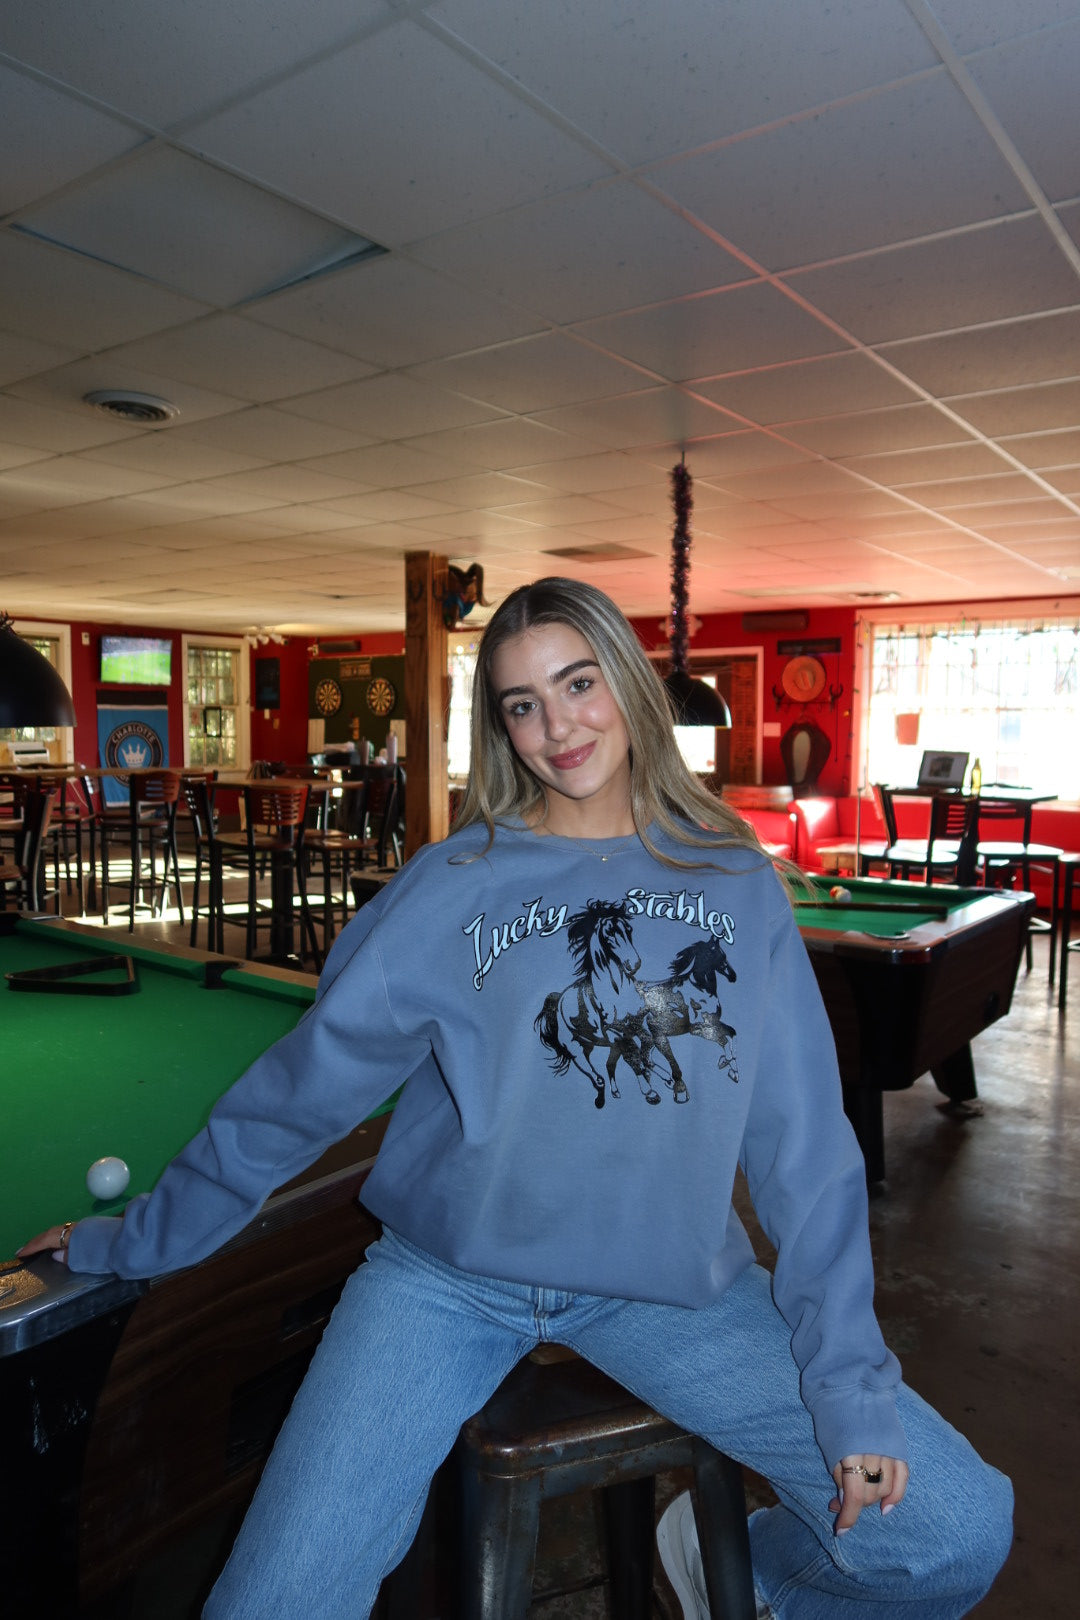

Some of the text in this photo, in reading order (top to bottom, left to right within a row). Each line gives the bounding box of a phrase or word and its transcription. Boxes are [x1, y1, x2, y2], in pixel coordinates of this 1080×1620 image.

[113, 725, 156, 743] CHARLOTTE
[463, 887, 736, 991] Lucky Stables
